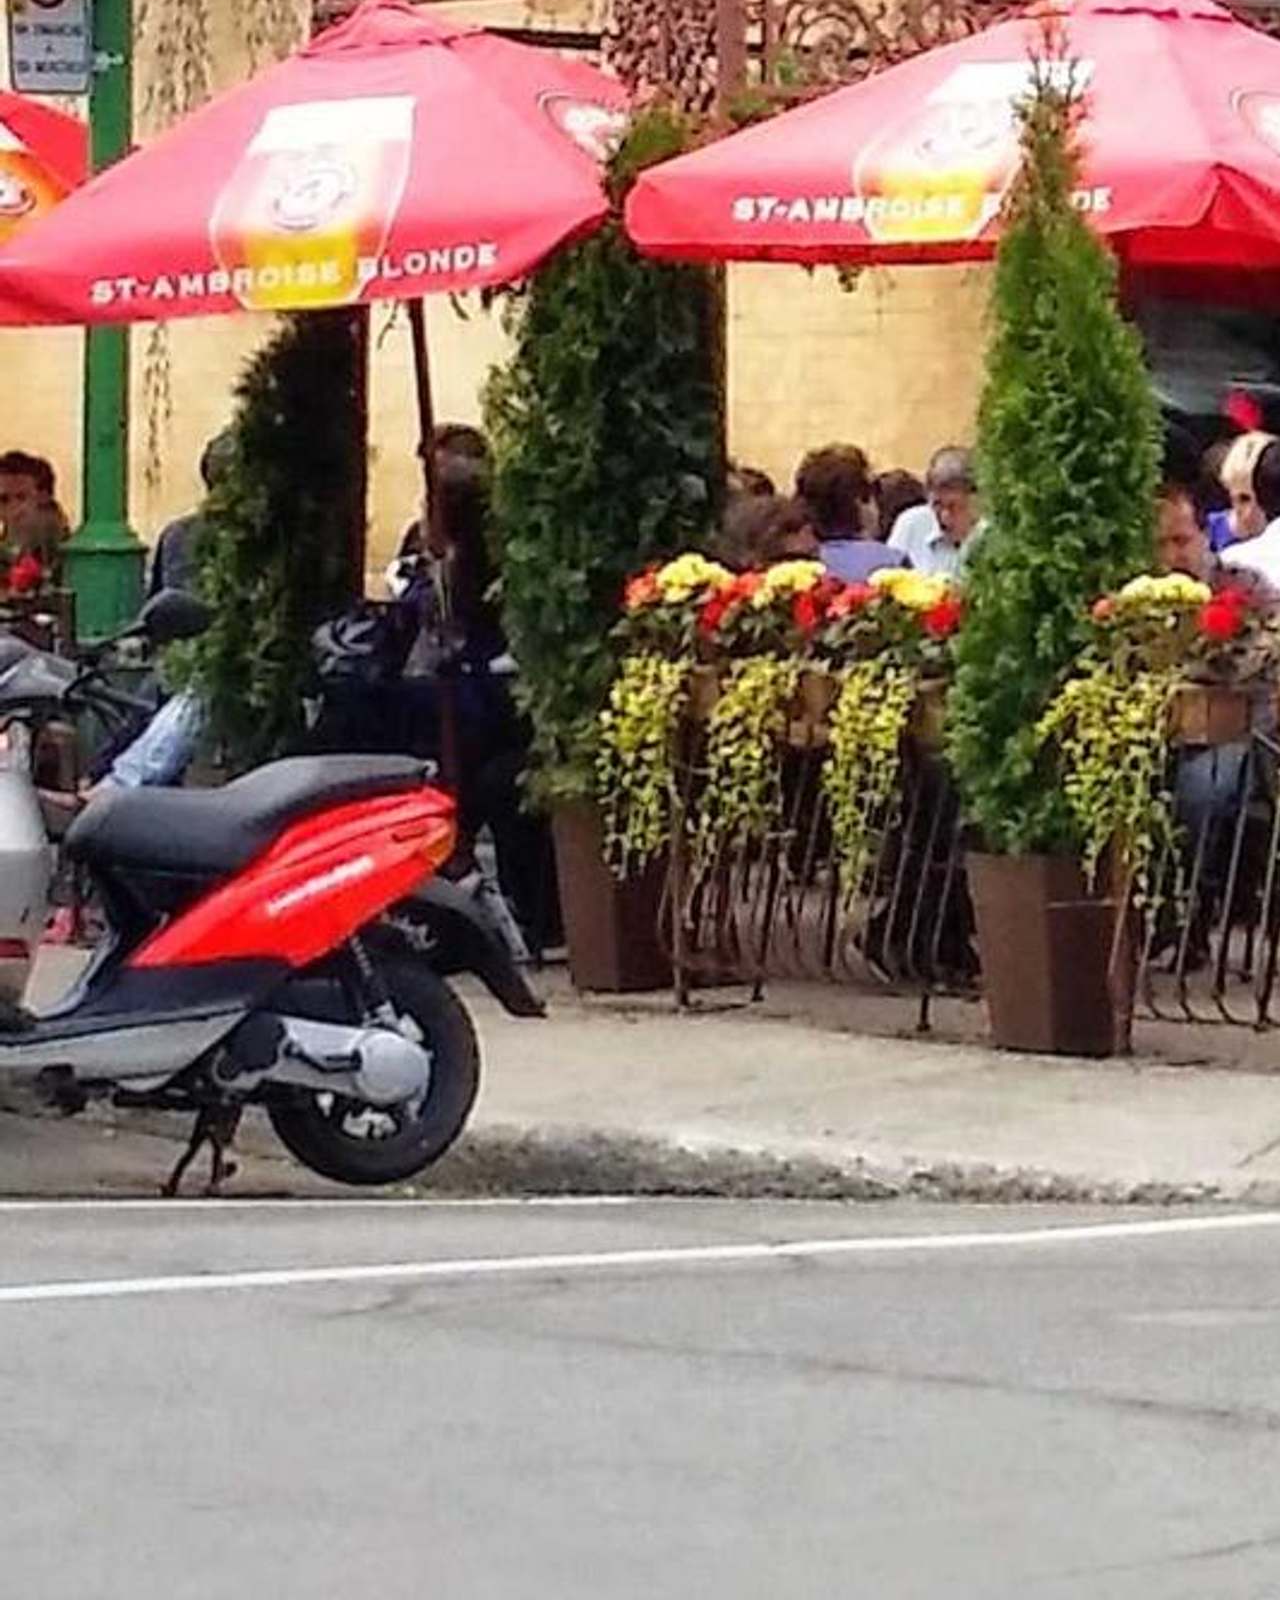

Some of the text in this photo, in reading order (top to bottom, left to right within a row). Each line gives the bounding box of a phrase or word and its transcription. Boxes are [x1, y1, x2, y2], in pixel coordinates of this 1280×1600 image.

[731, 192, 967, 223] ST-AMBROISE
[89, 242, 499, 306] ST-AMBROISE BLONDE
